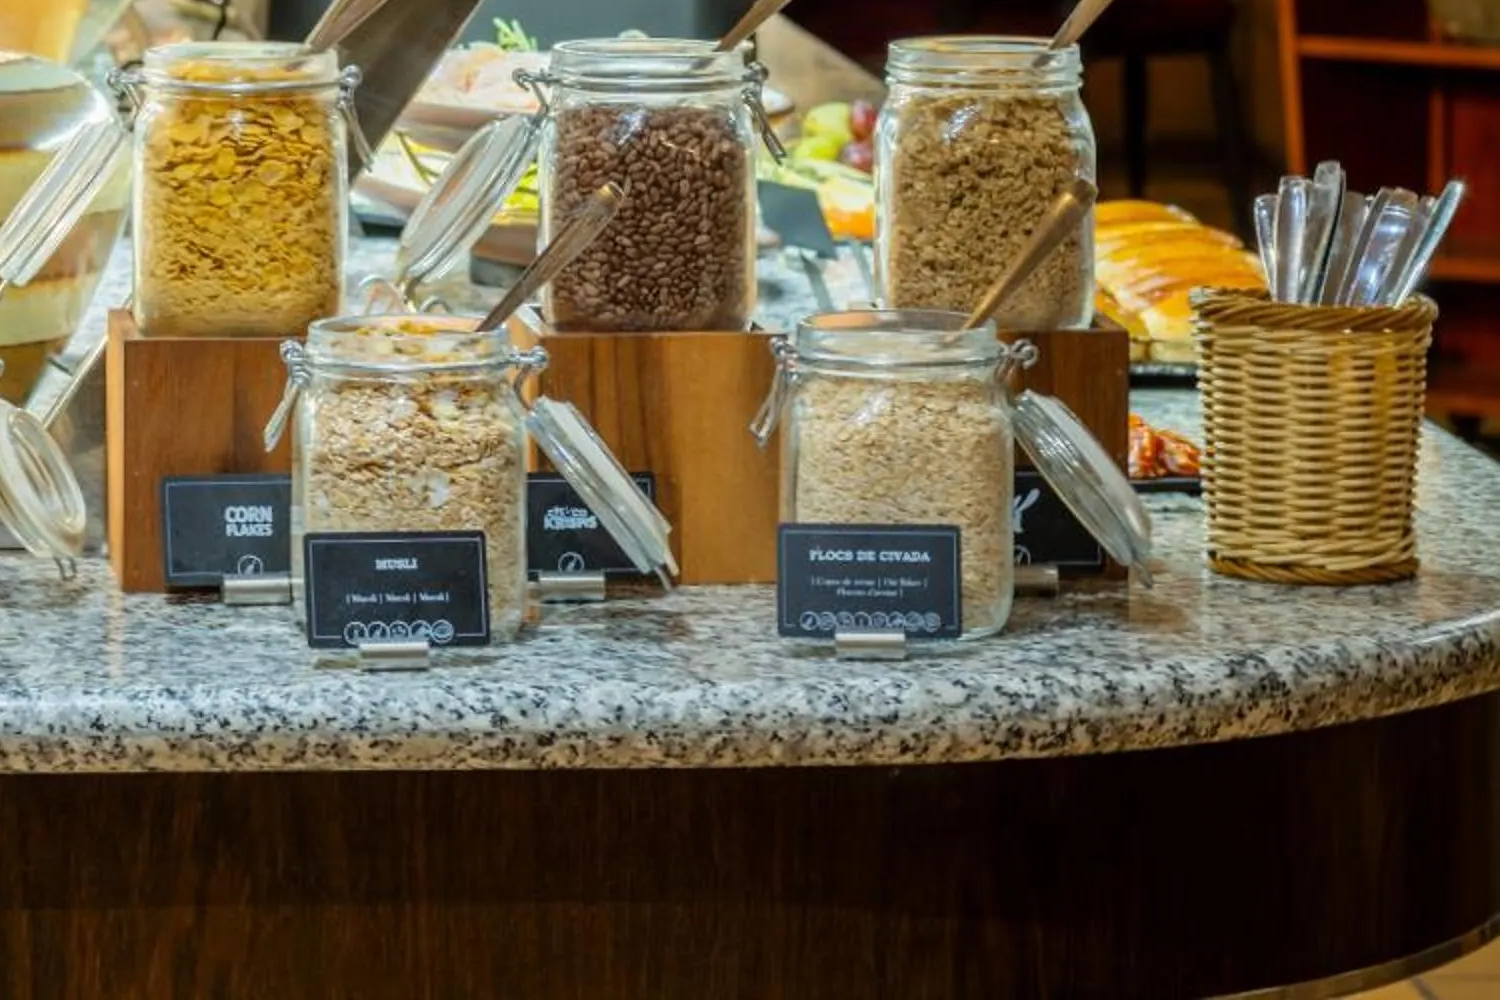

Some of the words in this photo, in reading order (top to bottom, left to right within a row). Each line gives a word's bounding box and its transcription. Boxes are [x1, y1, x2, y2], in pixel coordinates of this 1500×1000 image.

[225, 505, 273, 522] CORN
[226, 523, 274, 536] FLAKES
[809, 549, 853, 562] FLOCS
[856, 550, 876, 562] DE
[878, 551, 931, 562] CIVADA
